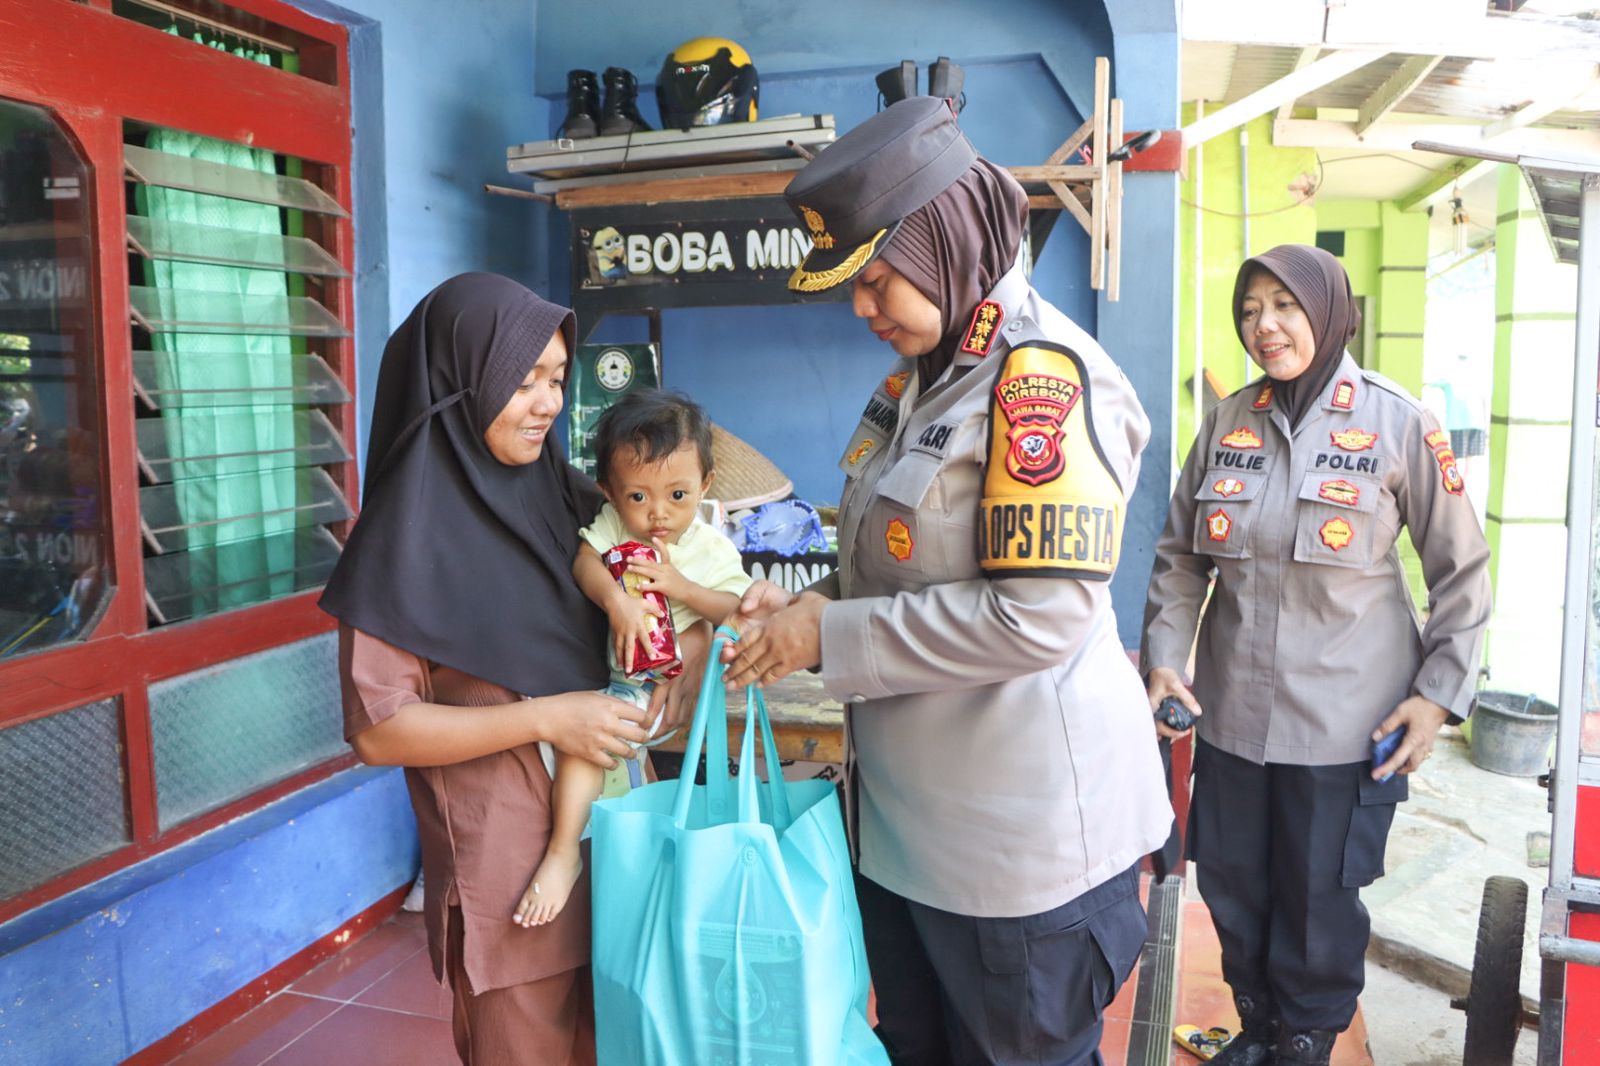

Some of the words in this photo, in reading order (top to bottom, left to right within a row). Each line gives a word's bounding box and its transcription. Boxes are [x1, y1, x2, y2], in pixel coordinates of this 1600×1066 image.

[627, 231, 734, 274] BOBA
[1000, 377, 1075, 398] POLRESTA
[1012, 405, 1033, 418] JAWA
[1034, 404, 1062, 417] BARAT
[1214, 450, 1267, 471] YULIE
[1315, 453, 1379, 475] POLRI
[1039, 503, 1116, 565] RESTA
